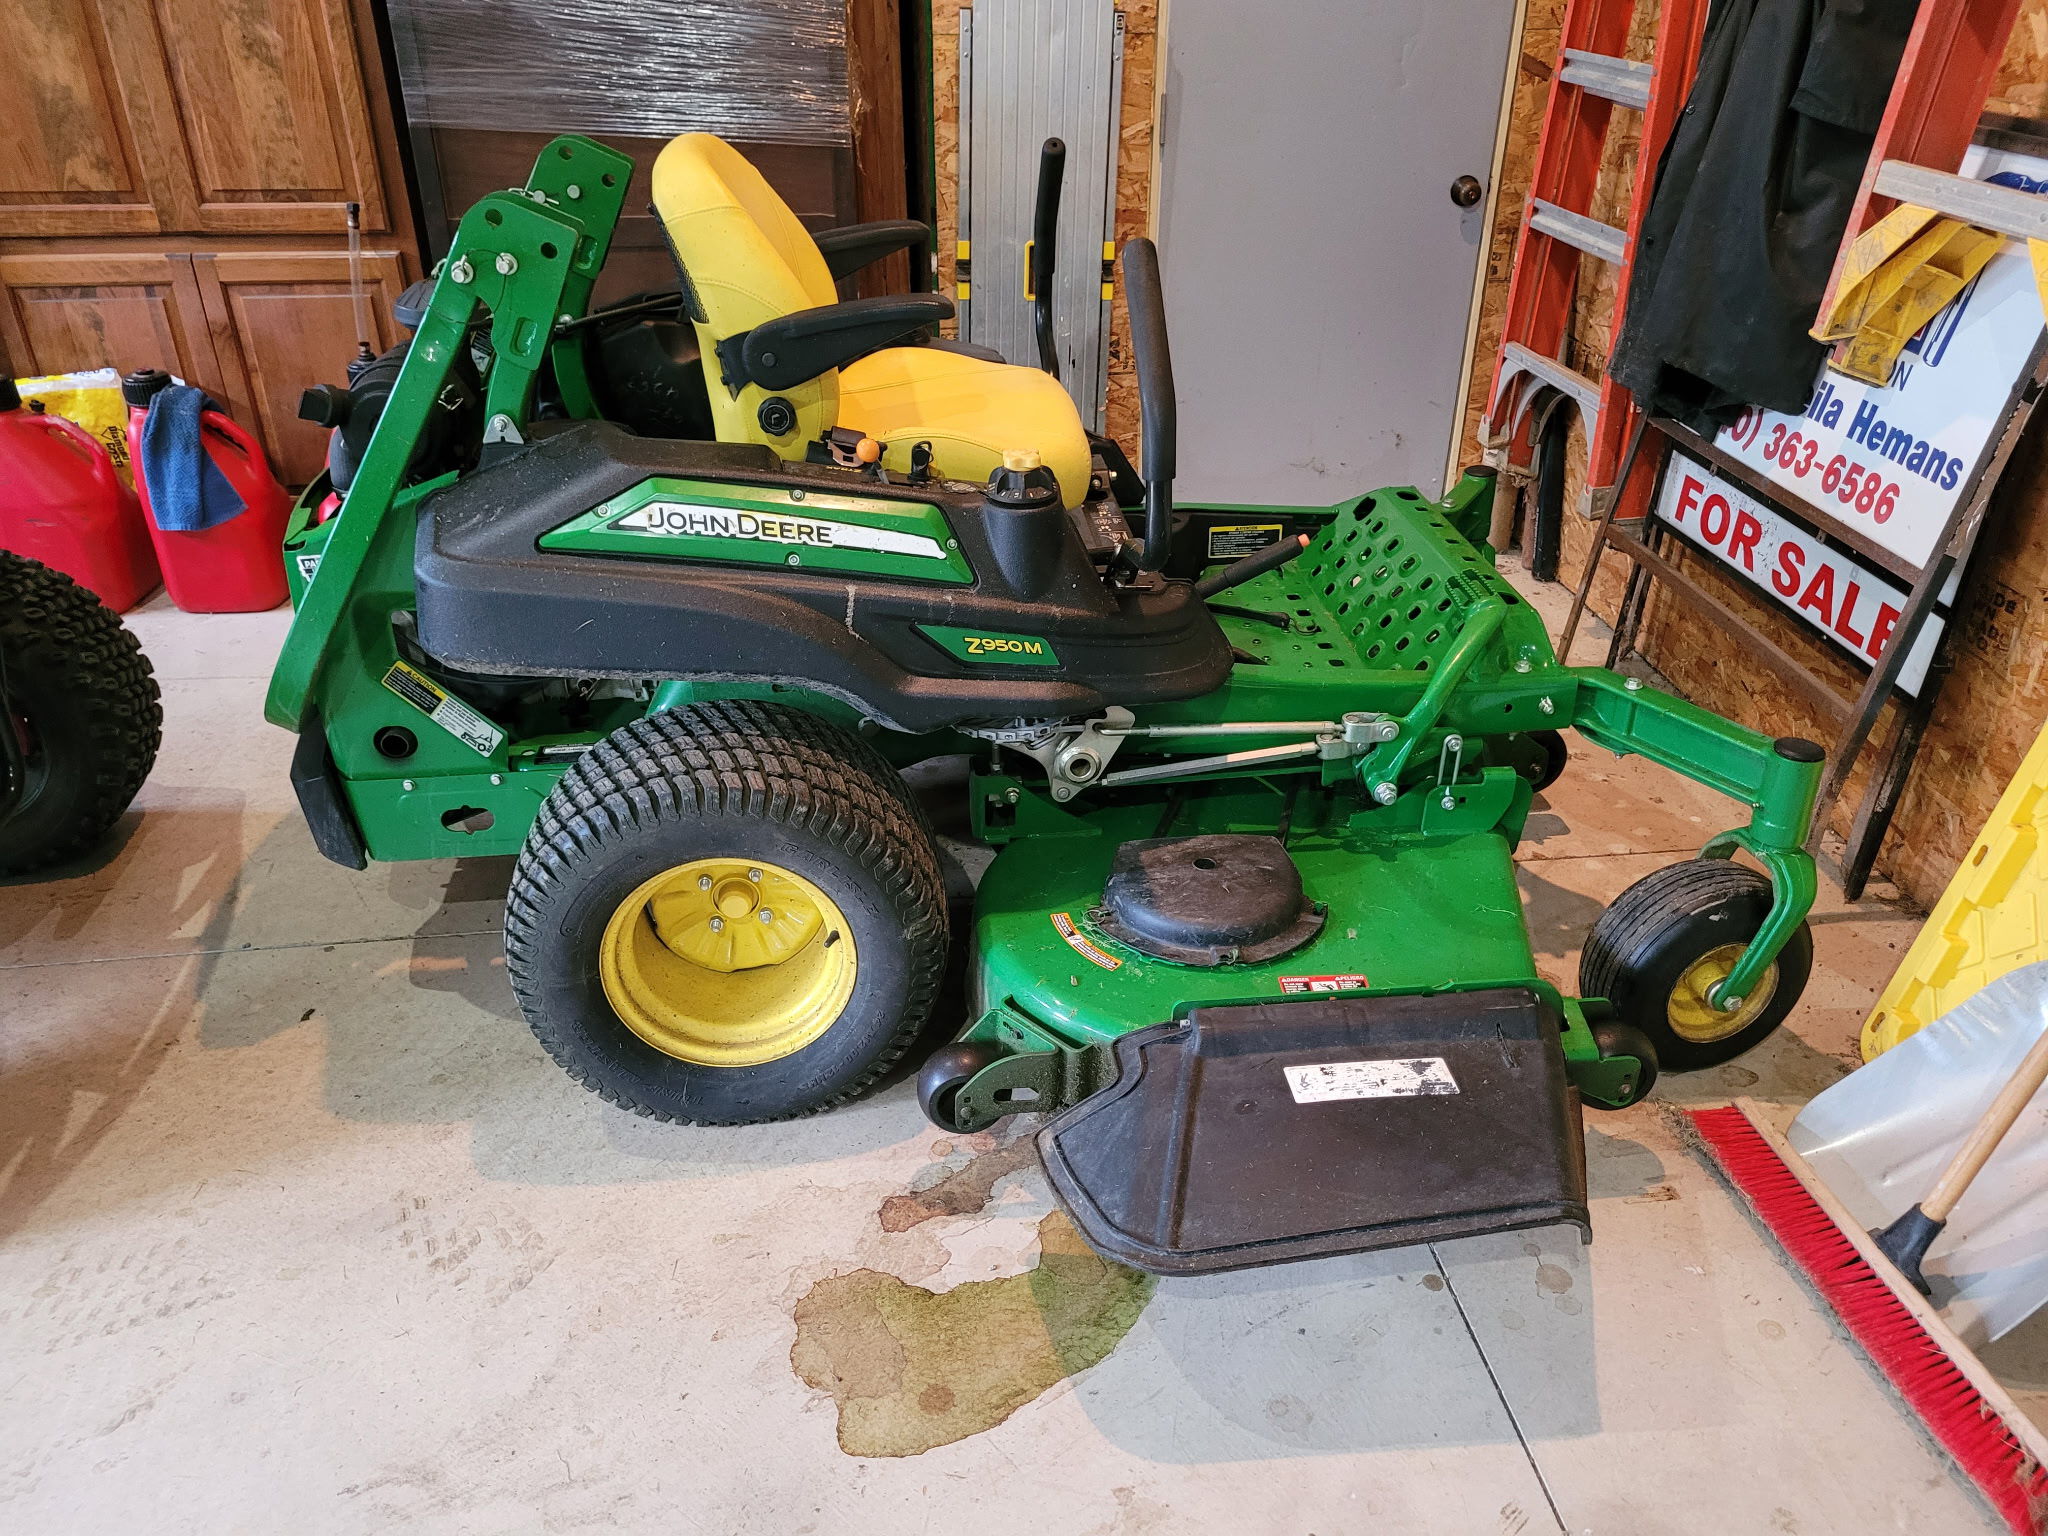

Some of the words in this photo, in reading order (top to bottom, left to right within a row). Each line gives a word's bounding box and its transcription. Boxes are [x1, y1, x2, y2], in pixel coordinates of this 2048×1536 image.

[1763, 423, 1901, 525] 363-6586
[1804, 381, 1844, 430] ila
[1846, 399, 1964, 491] Hemans
[649, 507, 731, 534] JOHN
[737, 513, 833, 544] DEERE
[1674, 474, 1763, 573] FOR
[1771, 541, 1903, 661] SALE
[412, 673, 437, 693] CAUTION
